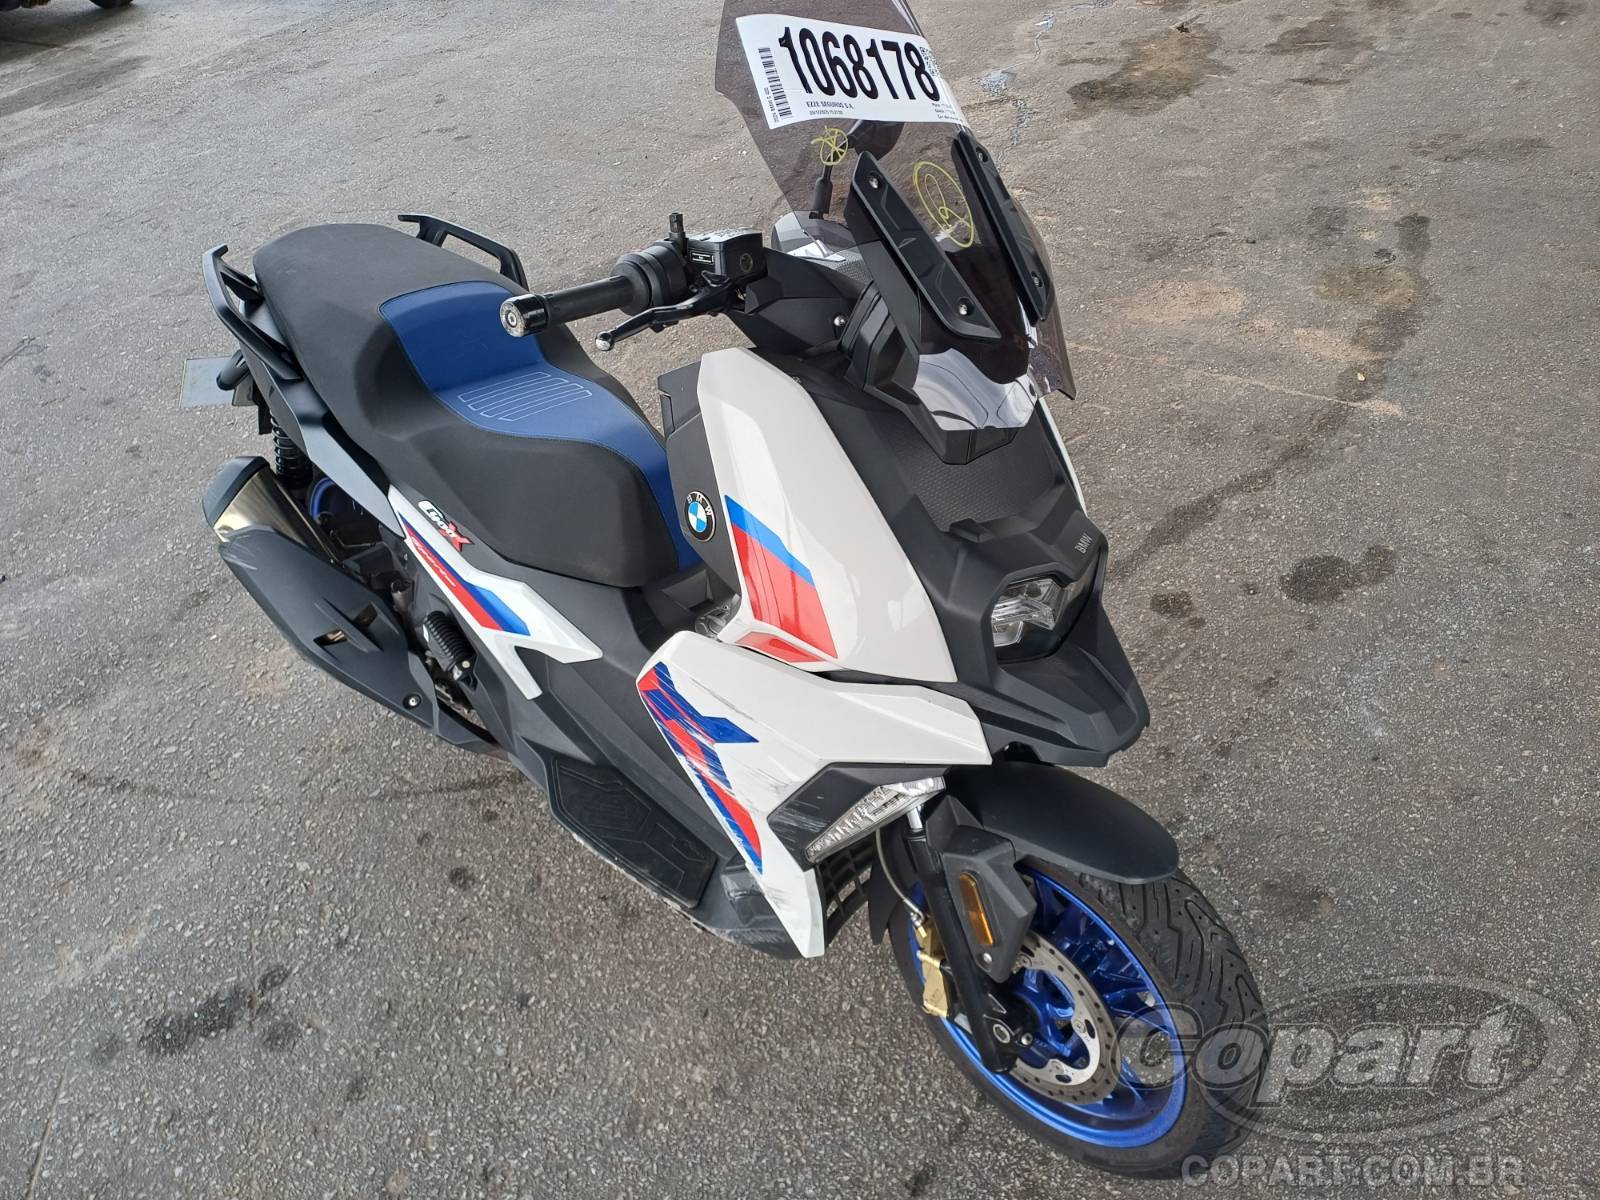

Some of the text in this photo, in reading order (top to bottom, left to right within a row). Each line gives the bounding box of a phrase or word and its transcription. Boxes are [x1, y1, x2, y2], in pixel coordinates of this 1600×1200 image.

[778, 26, 940, 101] 1068178
[686, 491, 712, 515] BMW
[1074, 532, 1093, 554] BMW
